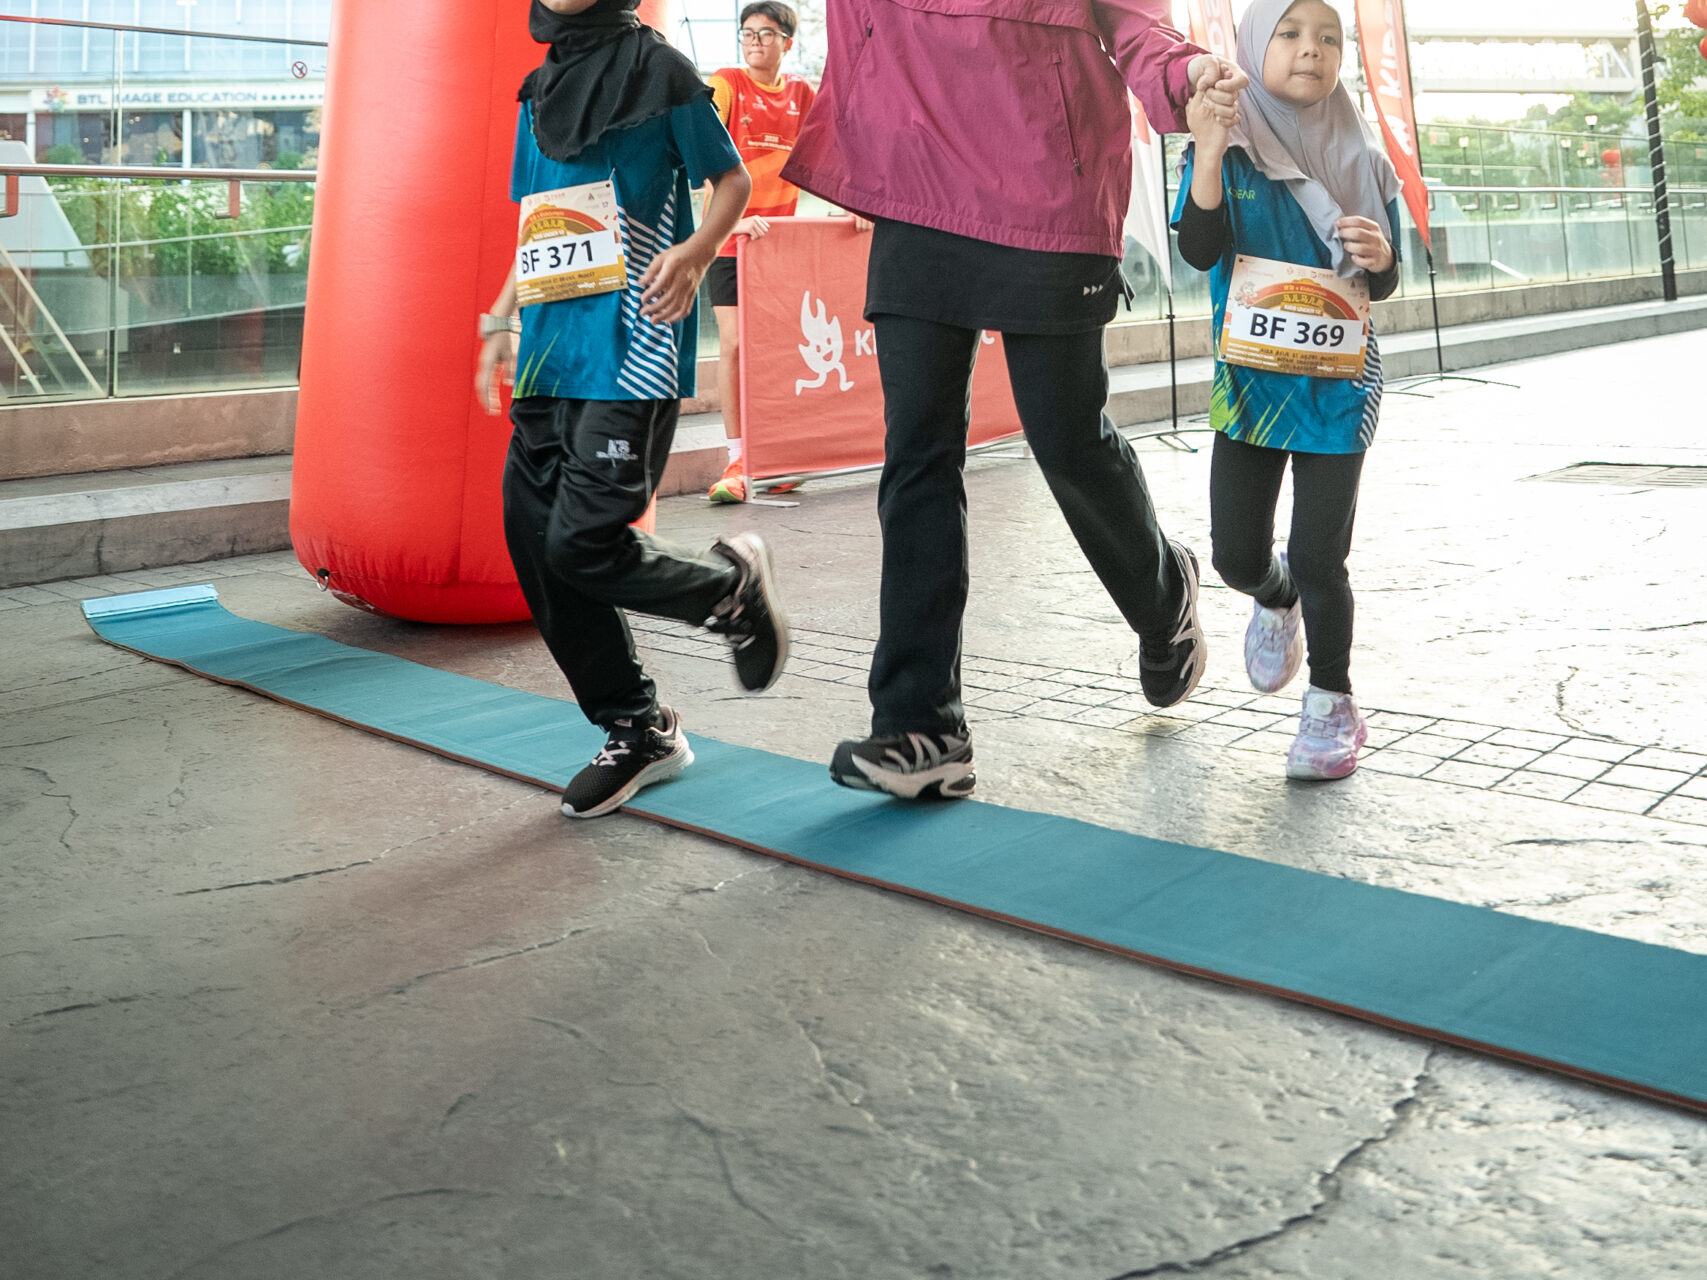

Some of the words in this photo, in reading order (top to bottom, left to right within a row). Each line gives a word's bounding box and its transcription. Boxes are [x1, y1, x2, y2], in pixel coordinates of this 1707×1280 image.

[77, 94, 107, 105] BTL
[167, 91, 258, 103] EDUCATION
[521, 248, 540, 274] BF
[547, 240, 593, 269] 371
[1250, 312, 1287, 340] BF
[1293, 321, 1345, 348] 369
